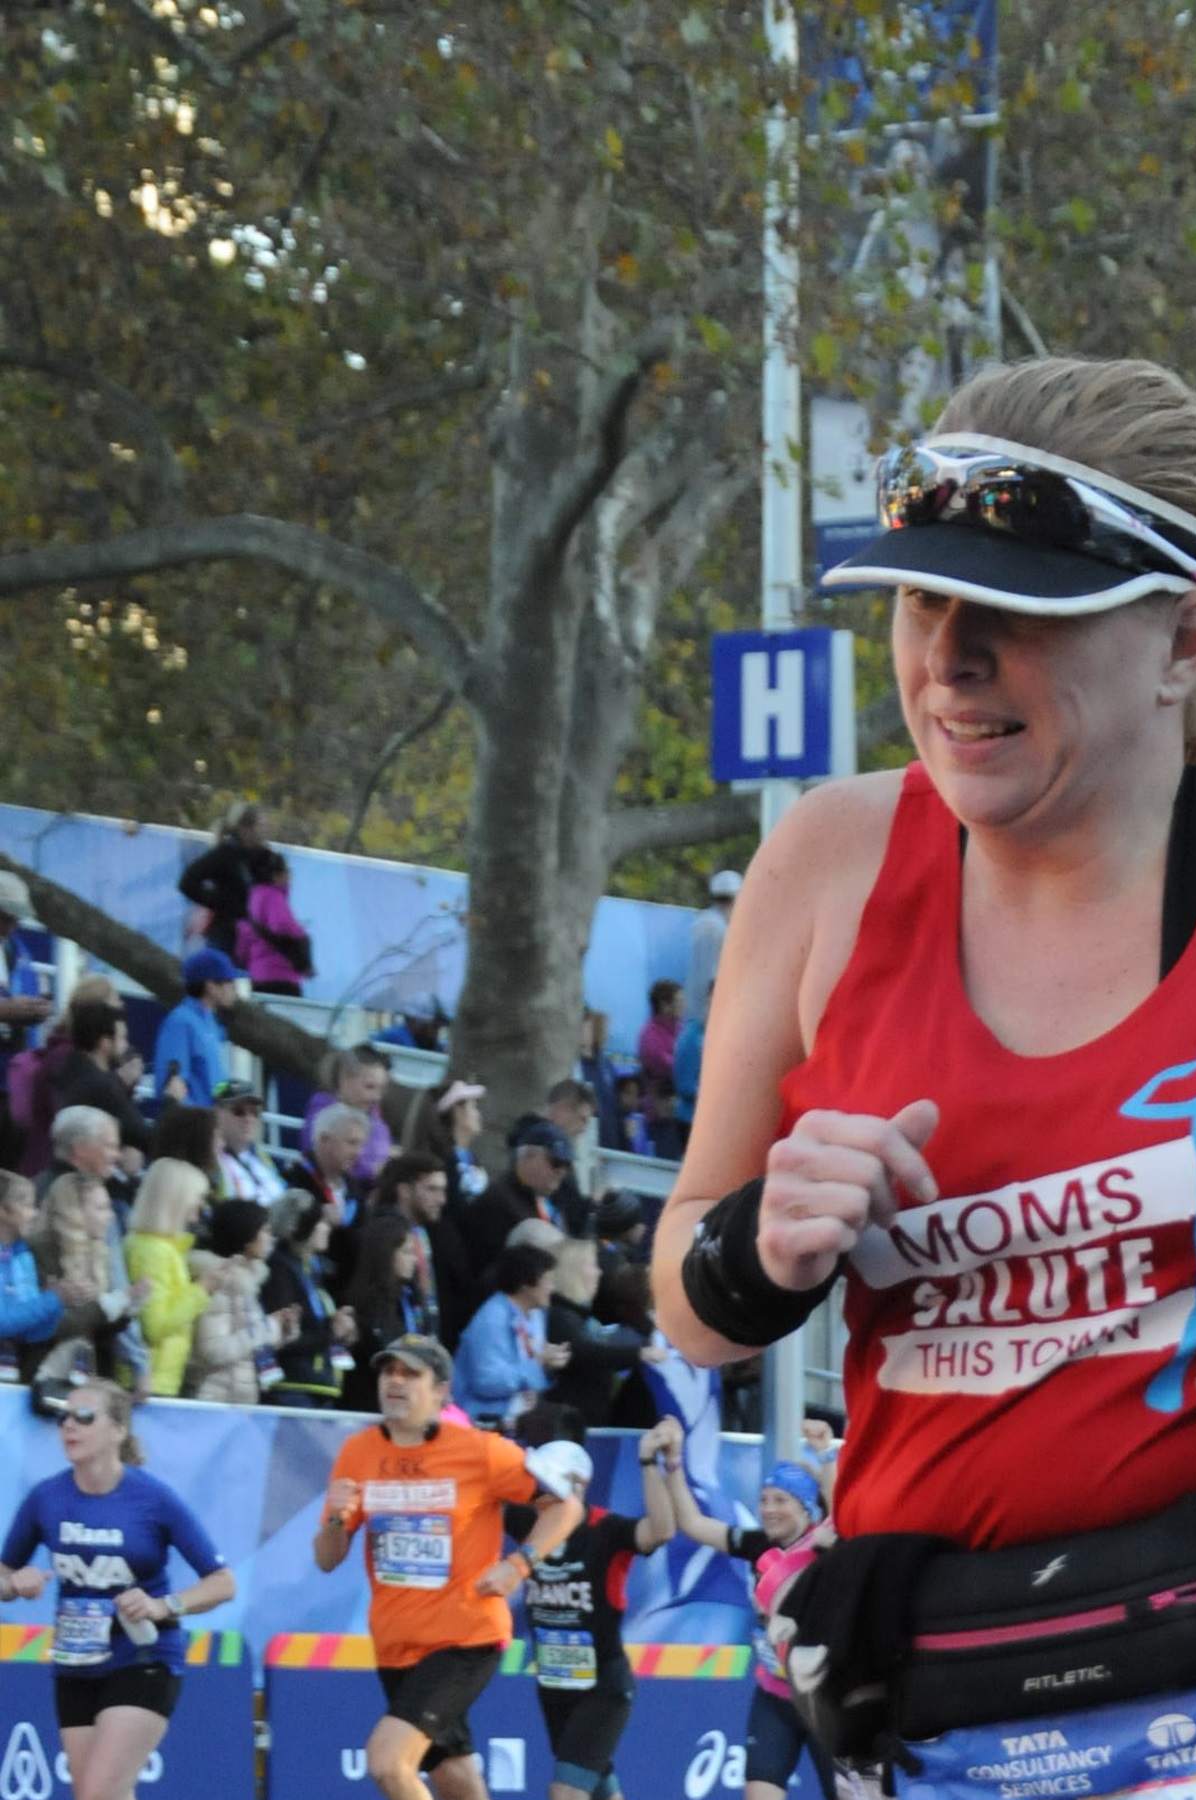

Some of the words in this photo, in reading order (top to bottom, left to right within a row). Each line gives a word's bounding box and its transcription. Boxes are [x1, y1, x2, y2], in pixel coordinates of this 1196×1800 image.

[741, 649, 805, 760] H
[888, 1167, 1142, 1268] MOMS
[912, 1237, 1157, 1327] SALUTE
[916, 1340, 994, 1378] THIS
[1023, 1664, 1105, 1692] FITLETIC
[1002, 1729, 1068, 1757] TATA
[966, 1744, 1112, 1781] CONSULTANCY
[1000, 1772, 1093, 1799] SERVICES
